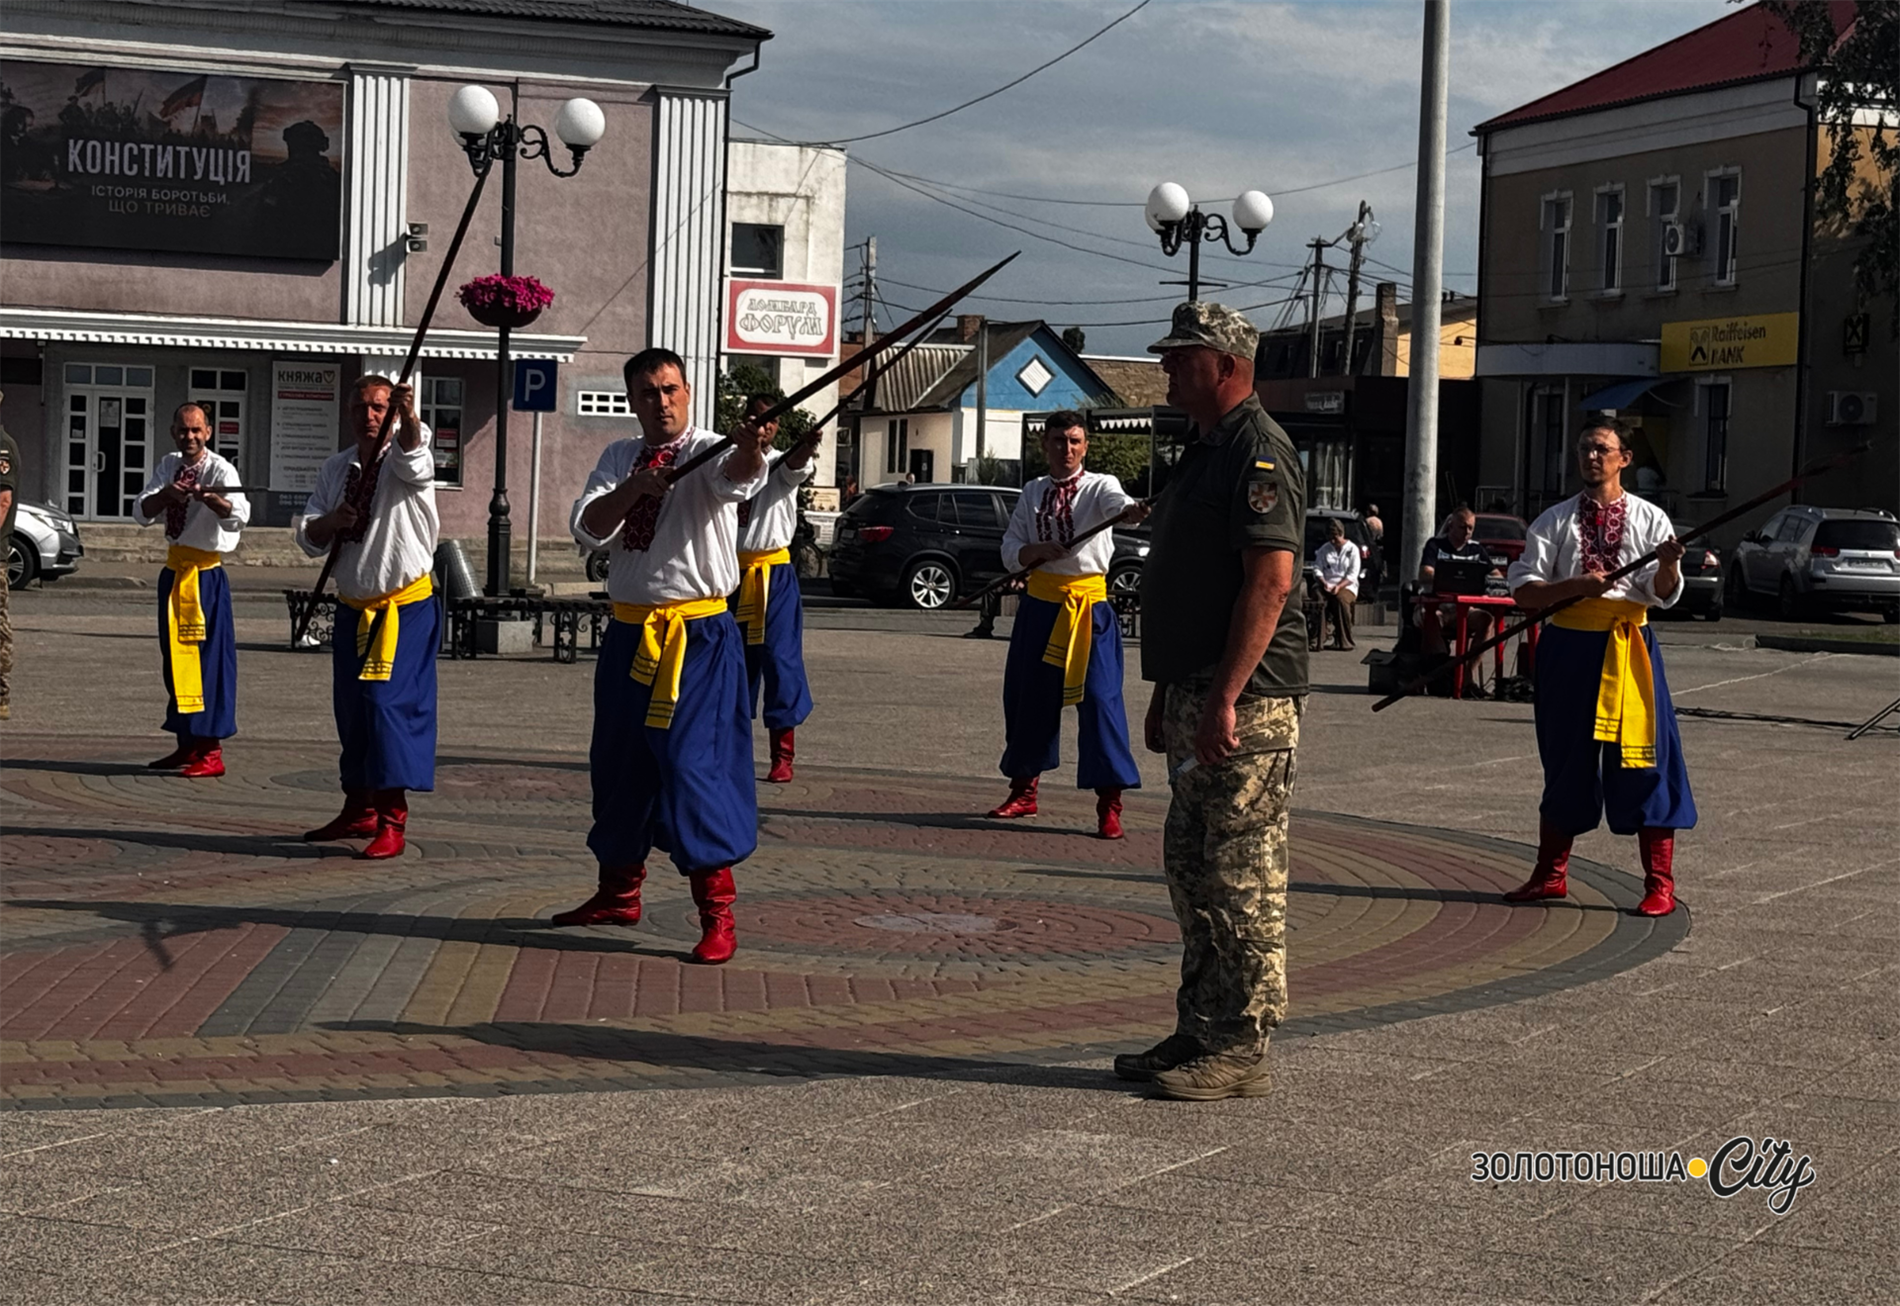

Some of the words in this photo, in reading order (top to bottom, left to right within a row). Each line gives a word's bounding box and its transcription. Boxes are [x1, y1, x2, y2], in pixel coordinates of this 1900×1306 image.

[67, 138, 252, 186] КОНСТИТУЦІЯ
[91, 185, 147, 199] ІСТОРІЯ
[108, 199, 139, 215] ЩО
[144, 201, 212, 217] ТРИВАЄ
[747, 298, 817, 316] ЛОМБАРД
[739, 313, 823, 340] ФОРУМ
[1711, 321, 1766, 343] Raiffeisen
[524, 368, 546, 402] P
